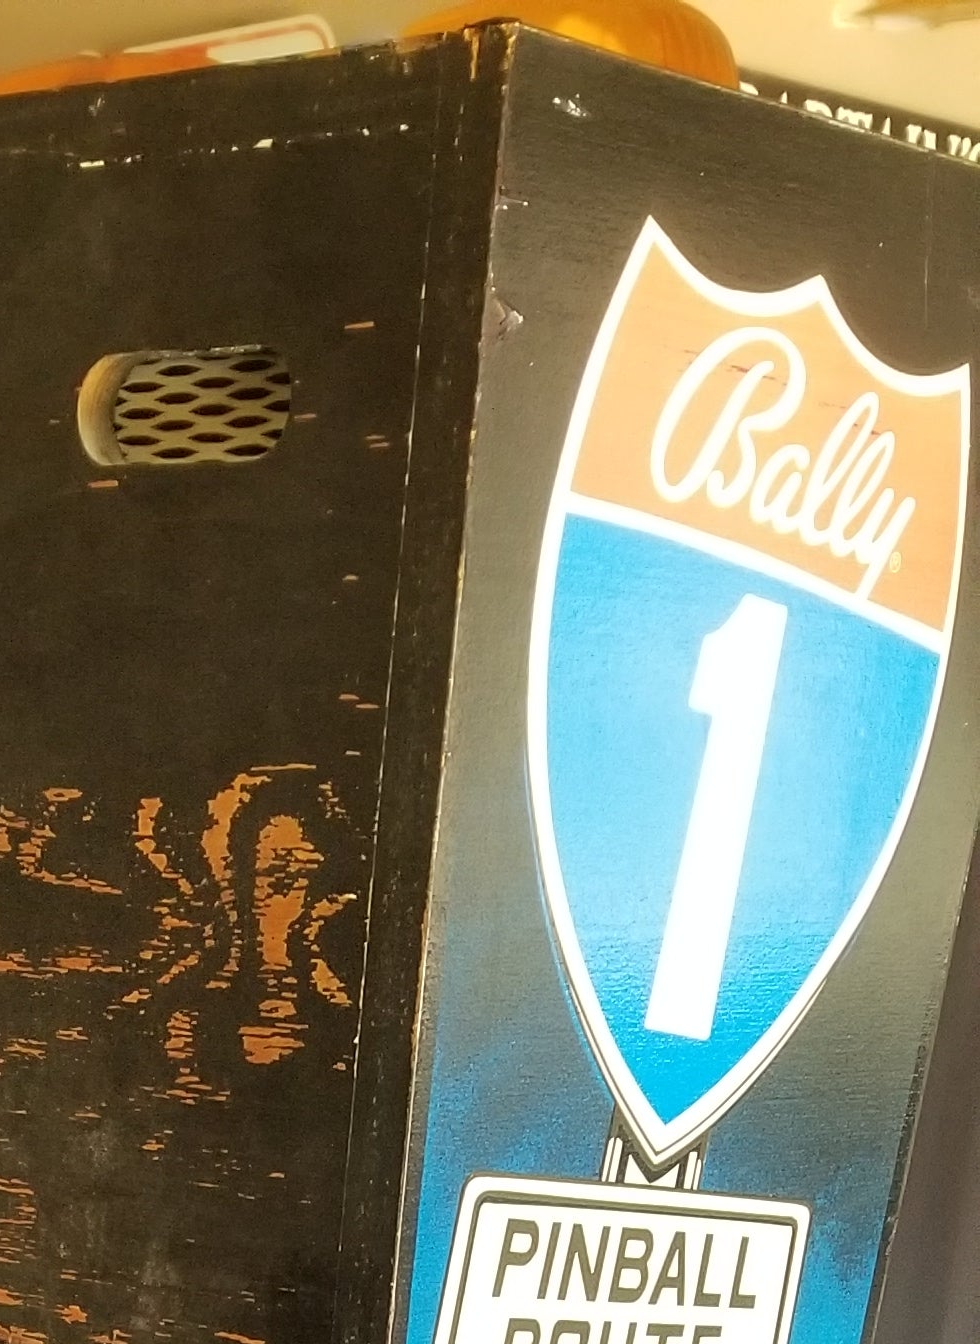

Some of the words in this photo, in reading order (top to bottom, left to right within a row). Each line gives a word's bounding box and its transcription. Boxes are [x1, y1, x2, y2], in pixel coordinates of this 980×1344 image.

[650, 326, 916, 601] Bally
[644, 592, 788, 1041] 1
[492, 1217, 757, 1310] PINBALL
